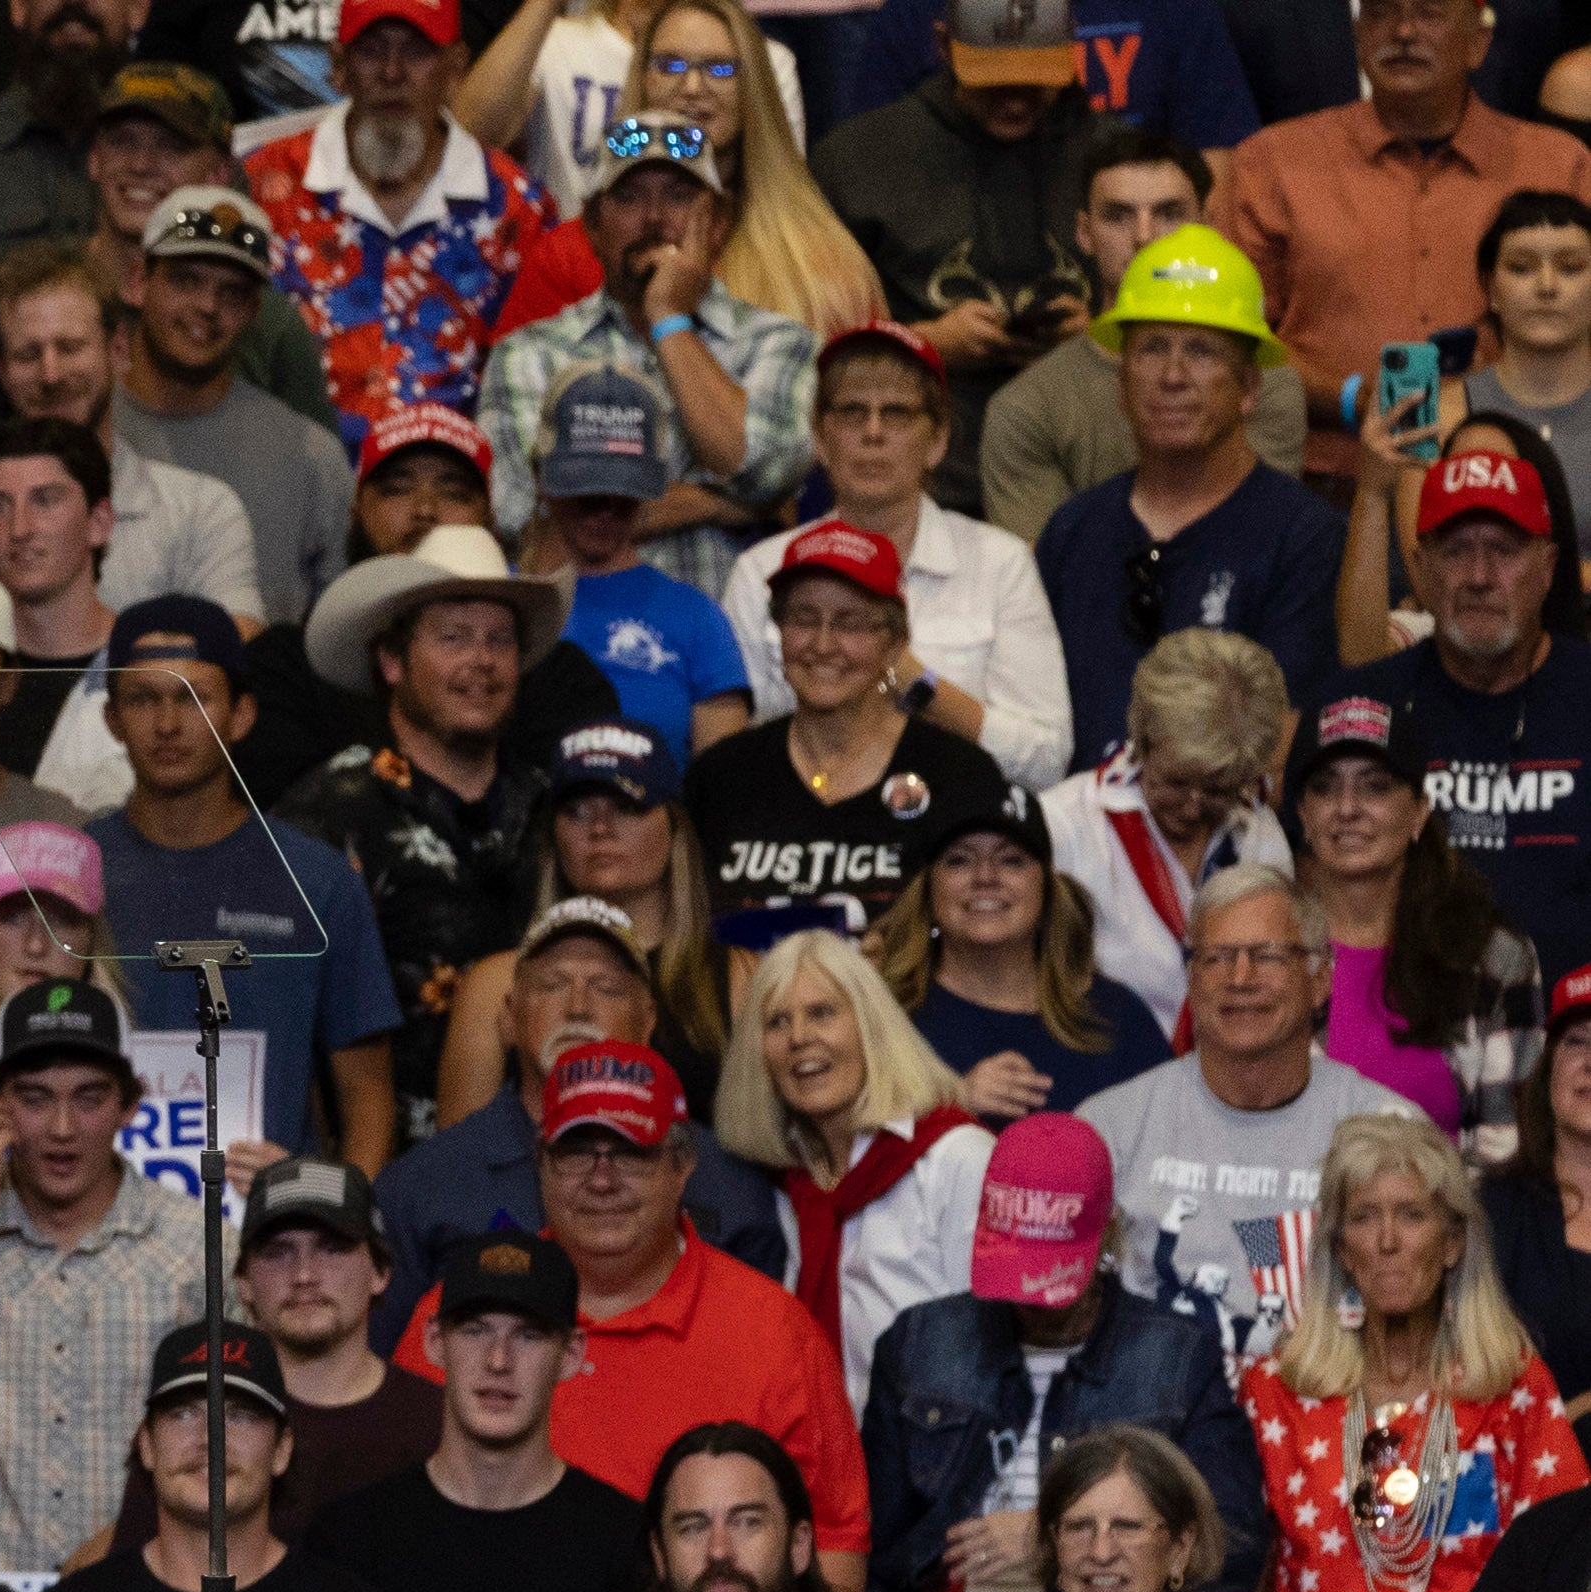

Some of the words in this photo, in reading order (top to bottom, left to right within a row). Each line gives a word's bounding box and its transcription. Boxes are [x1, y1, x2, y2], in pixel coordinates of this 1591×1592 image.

[1443, 455, 1518, 495] USA
[720, 841, 903, 885] JUSTICE
[1216, 1164, 1282, 1198] FIGHT!
[1288, 1169, 1321, 1200] FIG
